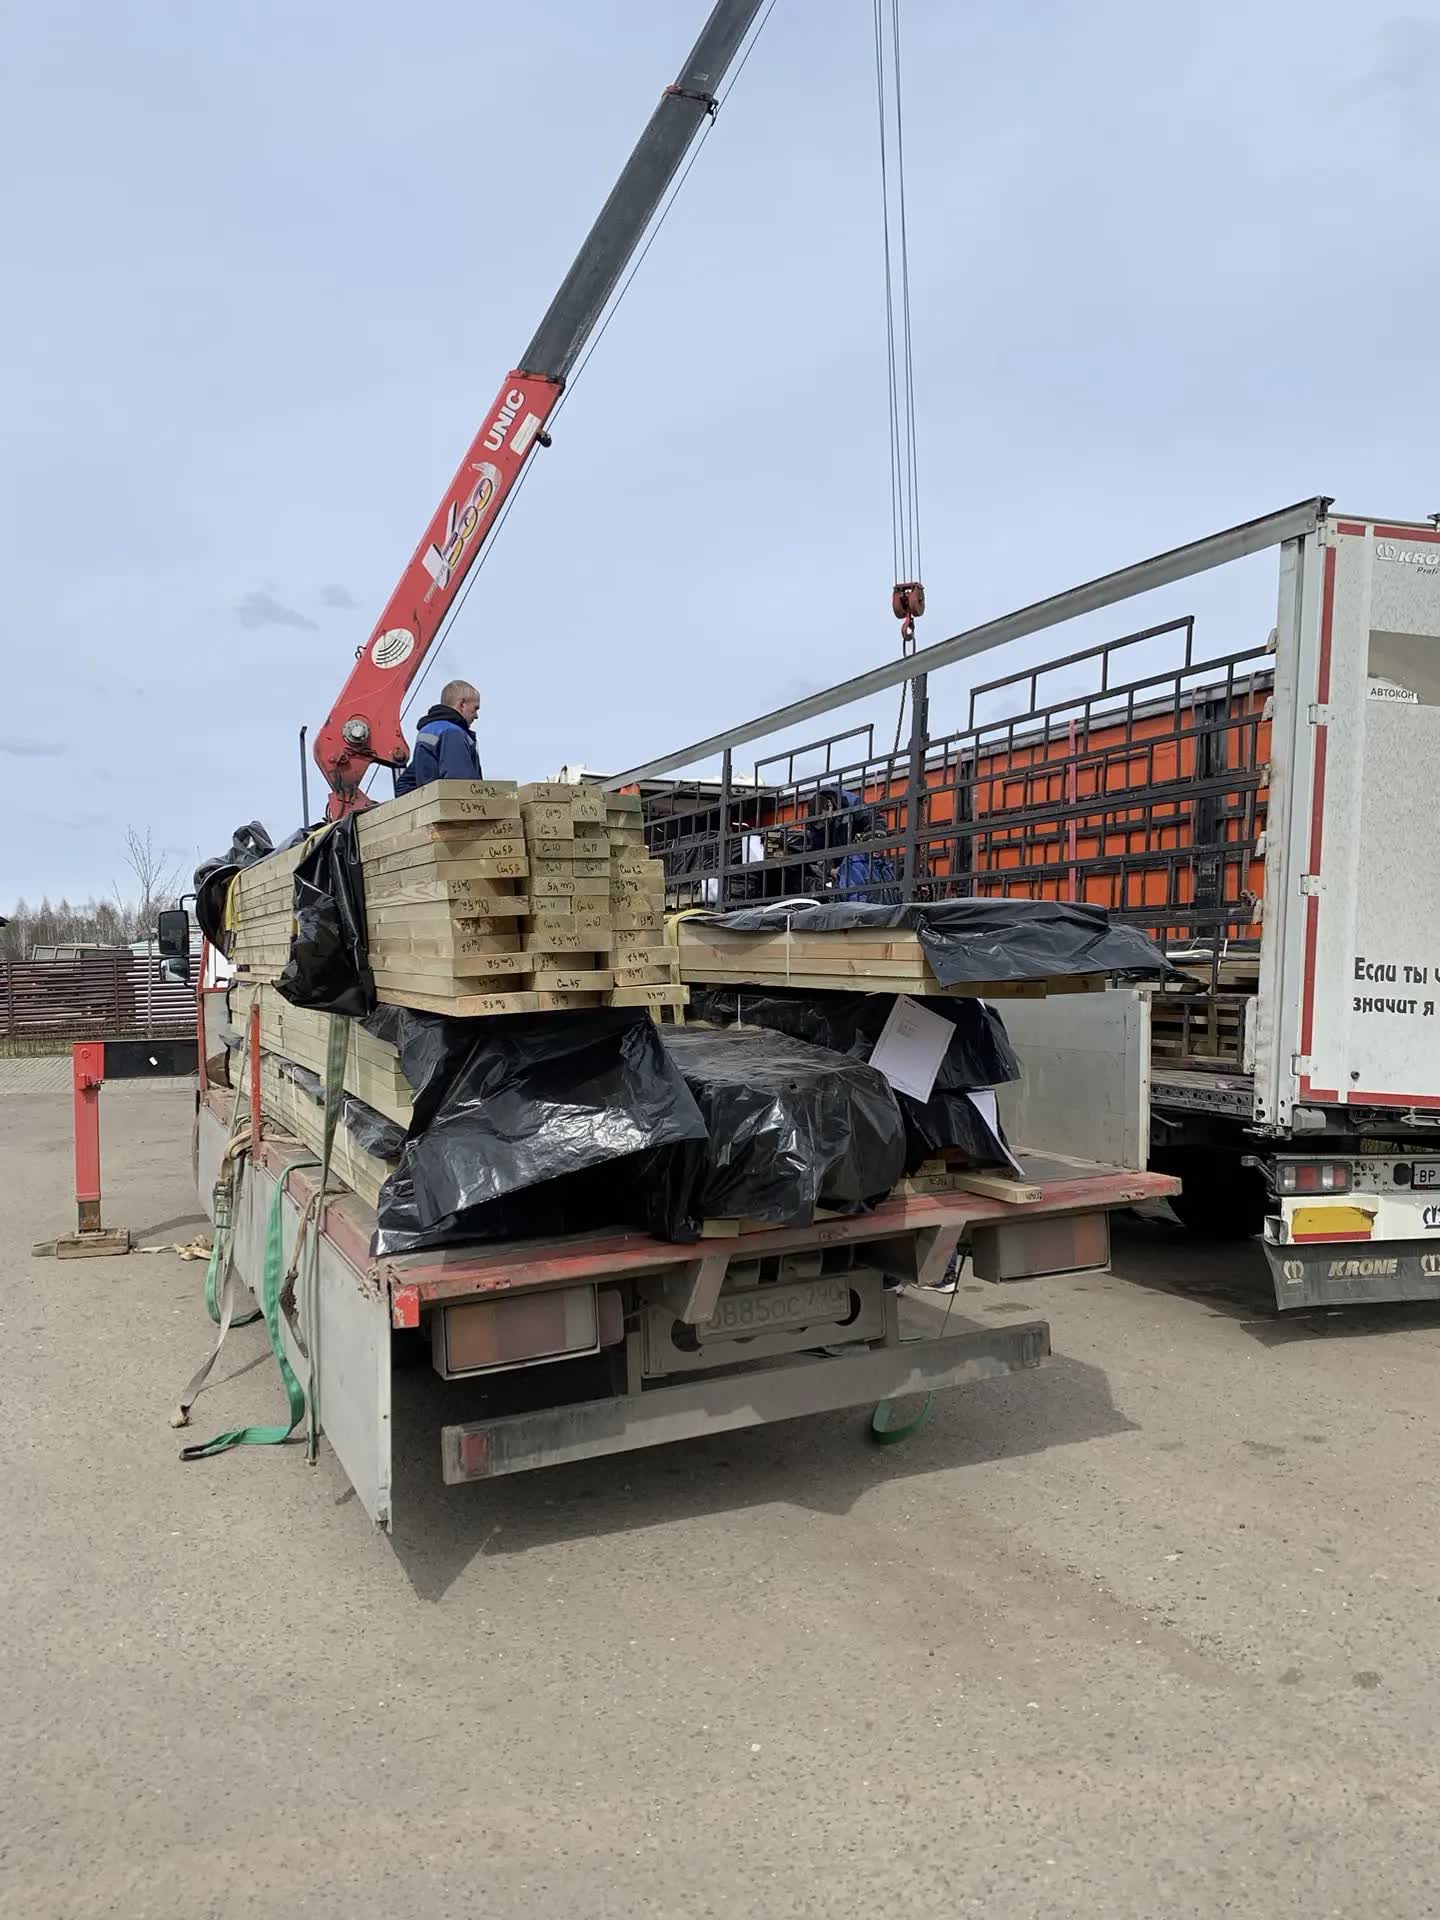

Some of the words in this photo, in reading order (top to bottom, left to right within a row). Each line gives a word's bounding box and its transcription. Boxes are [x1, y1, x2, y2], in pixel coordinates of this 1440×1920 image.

[483, 389, 525, 451] UNIC
[1398, 551, 1440, 566] KRO
[1370, 688, 1419, 700] АВТОКОН
[1354, 957, 1396, 983] Если
[1403, 966, 1428, 984] ты
[1353, 997, 1418, 1015] значит
[1422, 1001, 1434, 1016] я
[1328, 1258, 1398, 1277] KRONE
